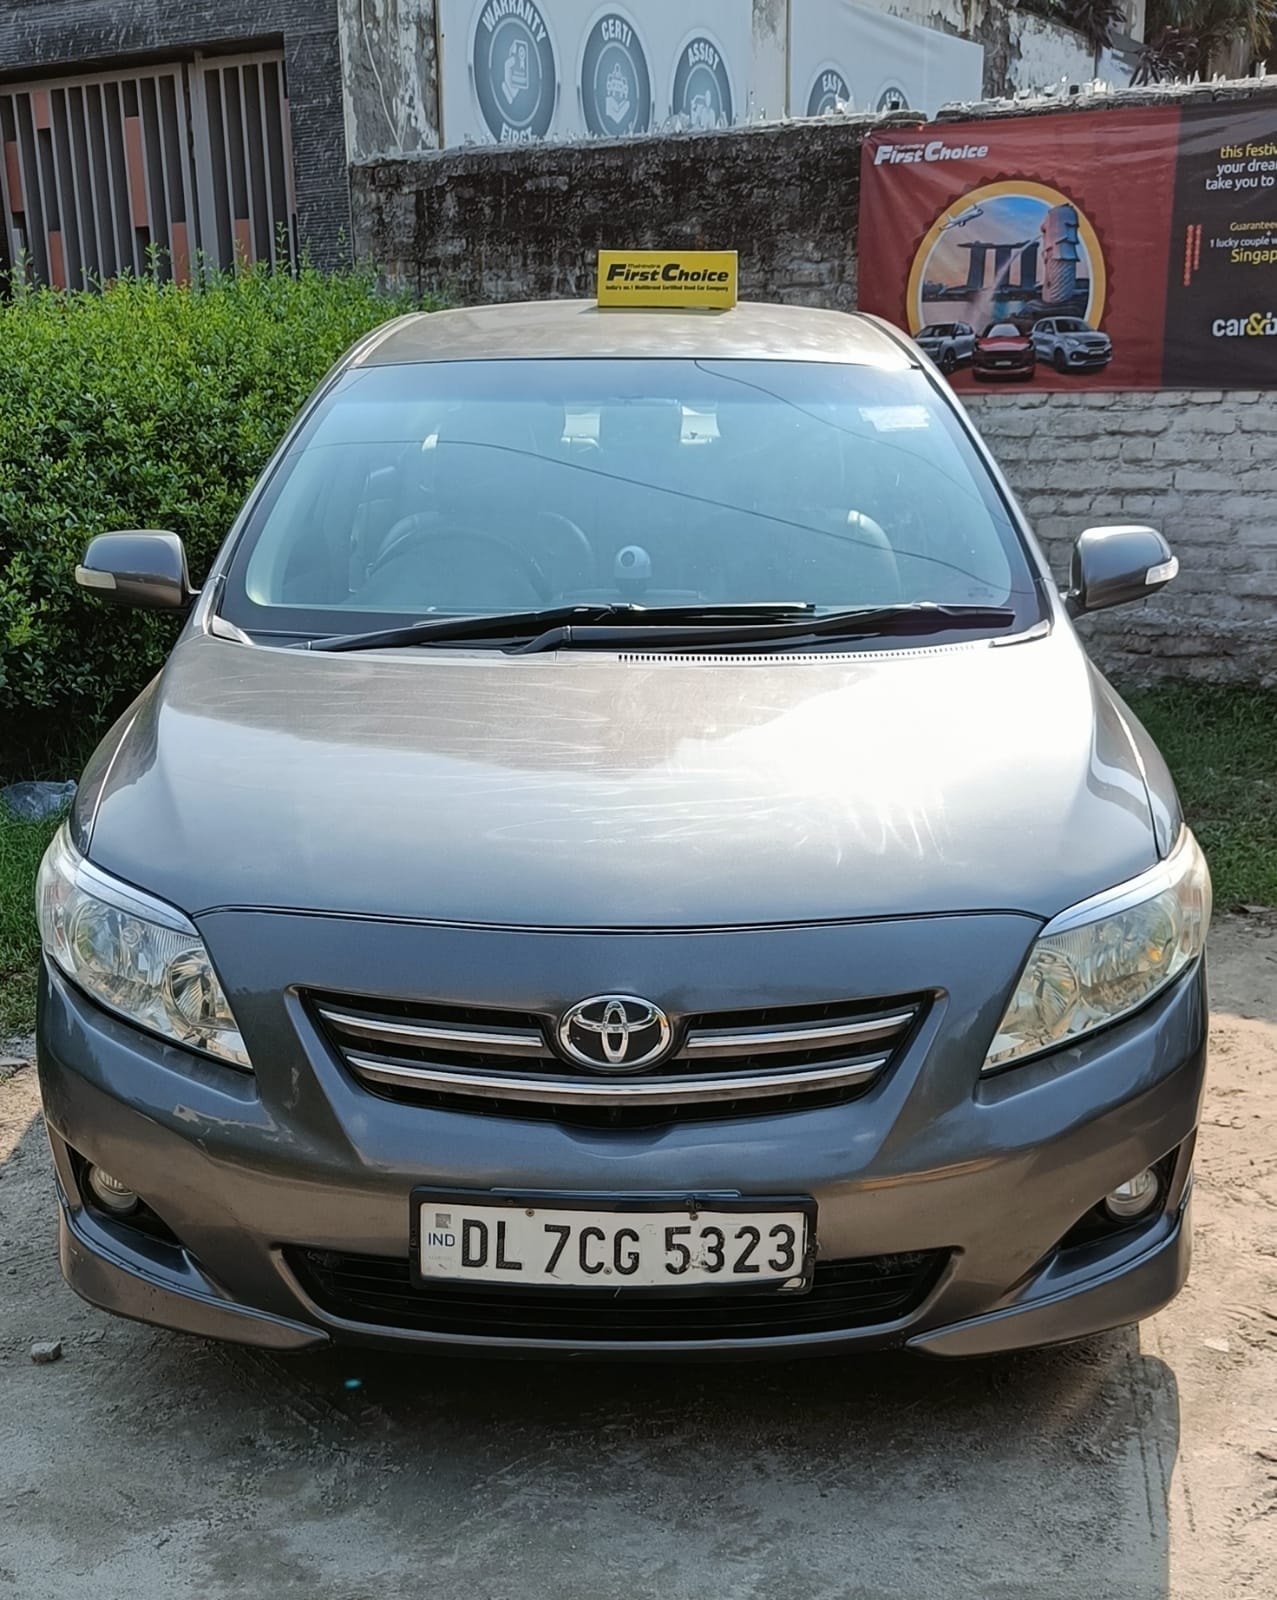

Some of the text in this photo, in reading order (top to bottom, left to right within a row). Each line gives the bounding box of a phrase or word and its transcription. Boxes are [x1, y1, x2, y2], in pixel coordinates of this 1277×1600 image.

[482, 0, 547, 43] WARRANTY
[601, 19, 632, 47] CERTI
[688, 42, 720, 70] ASSIST
[822, 73, 843, 95] EASY
[1220, 145, 1243, 159] this
[1216, 159, 1277, 177] your drea
[1205, 175, 1274, 191] take you to
[1215, 237, 1239, 248] lucky
[1240, 236, 1270, 246] couple
[428, 1232, 456, 1247] IND
[462, 1218, 796, 1276] DL 7CG 5323
